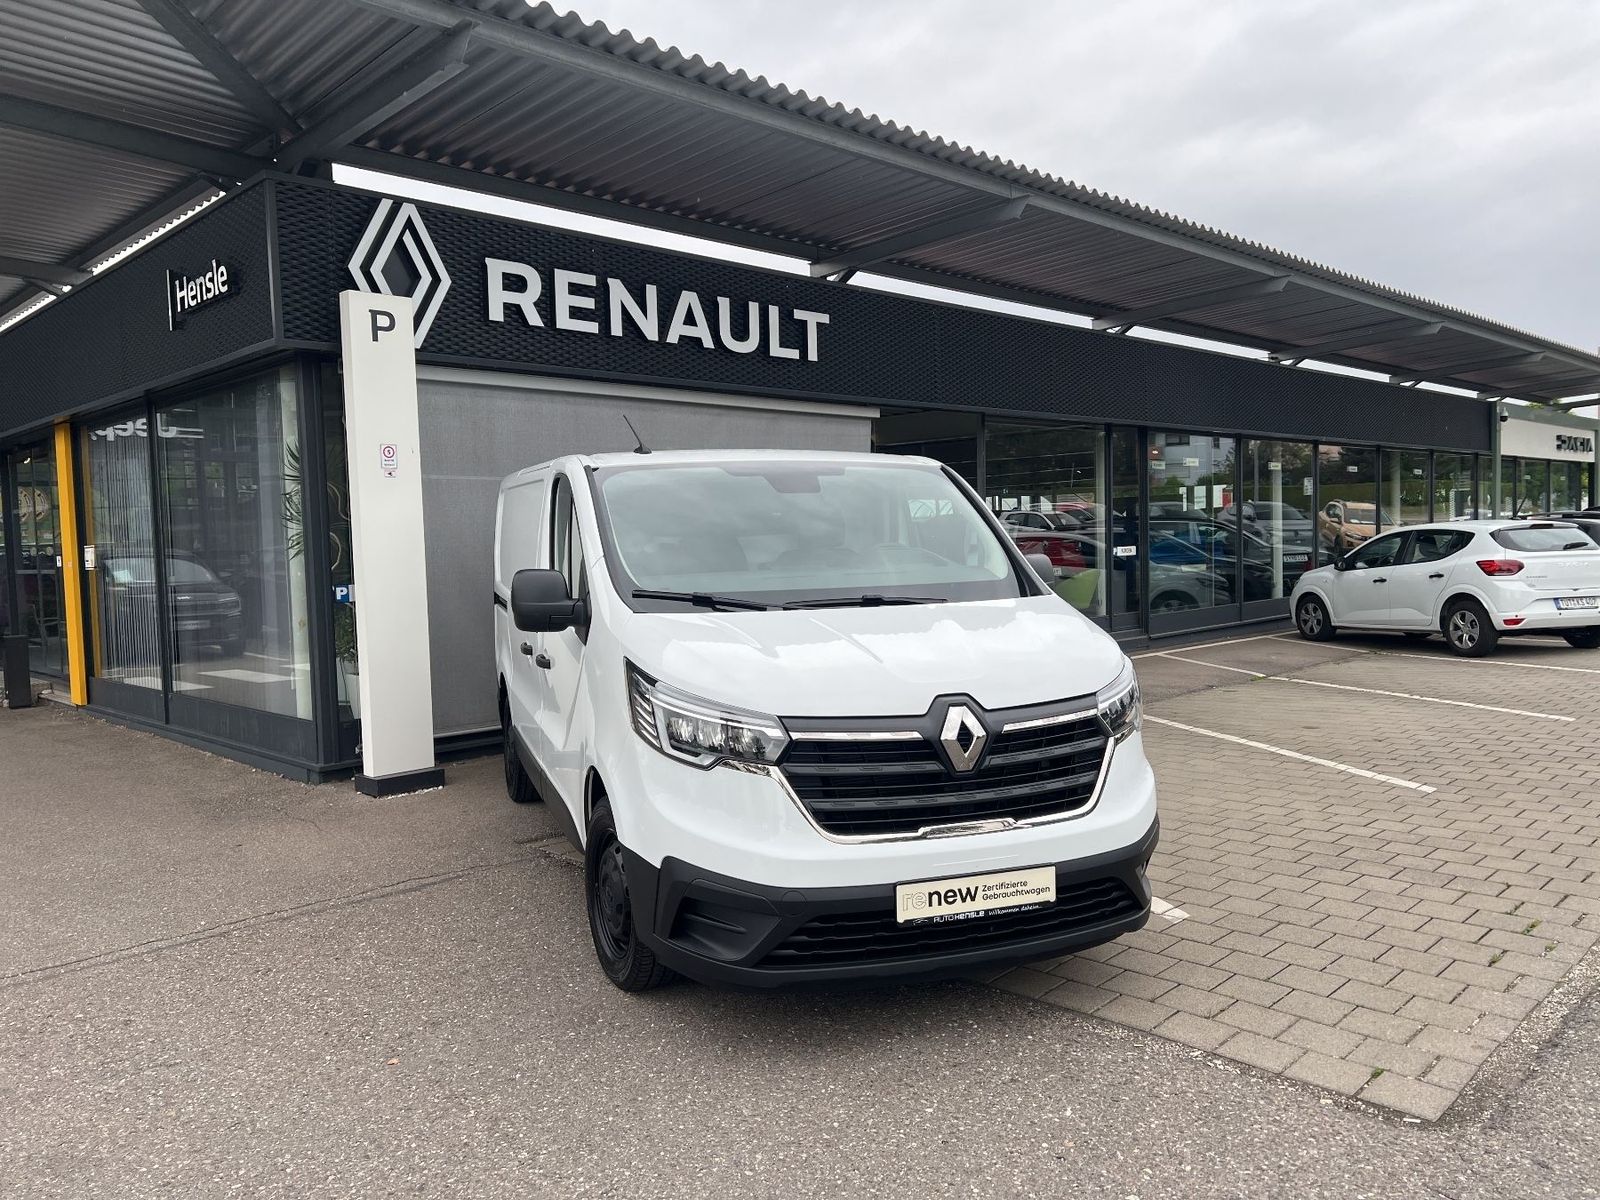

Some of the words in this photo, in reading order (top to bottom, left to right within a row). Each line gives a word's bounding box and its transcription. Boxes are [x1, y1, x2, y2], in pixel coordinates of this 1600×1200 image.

[175, 259, 228, 312] Hensle
[485, 257, 830, 362] RENAULT
[368, 309, 396, 342] P
[336, 587, 348, 600] P
[902, 886, 979, 911] renew
[982, 880, 1028, 892] Zertifizierte
[982, 886, 1050, 900] Gebrauchtwagen
